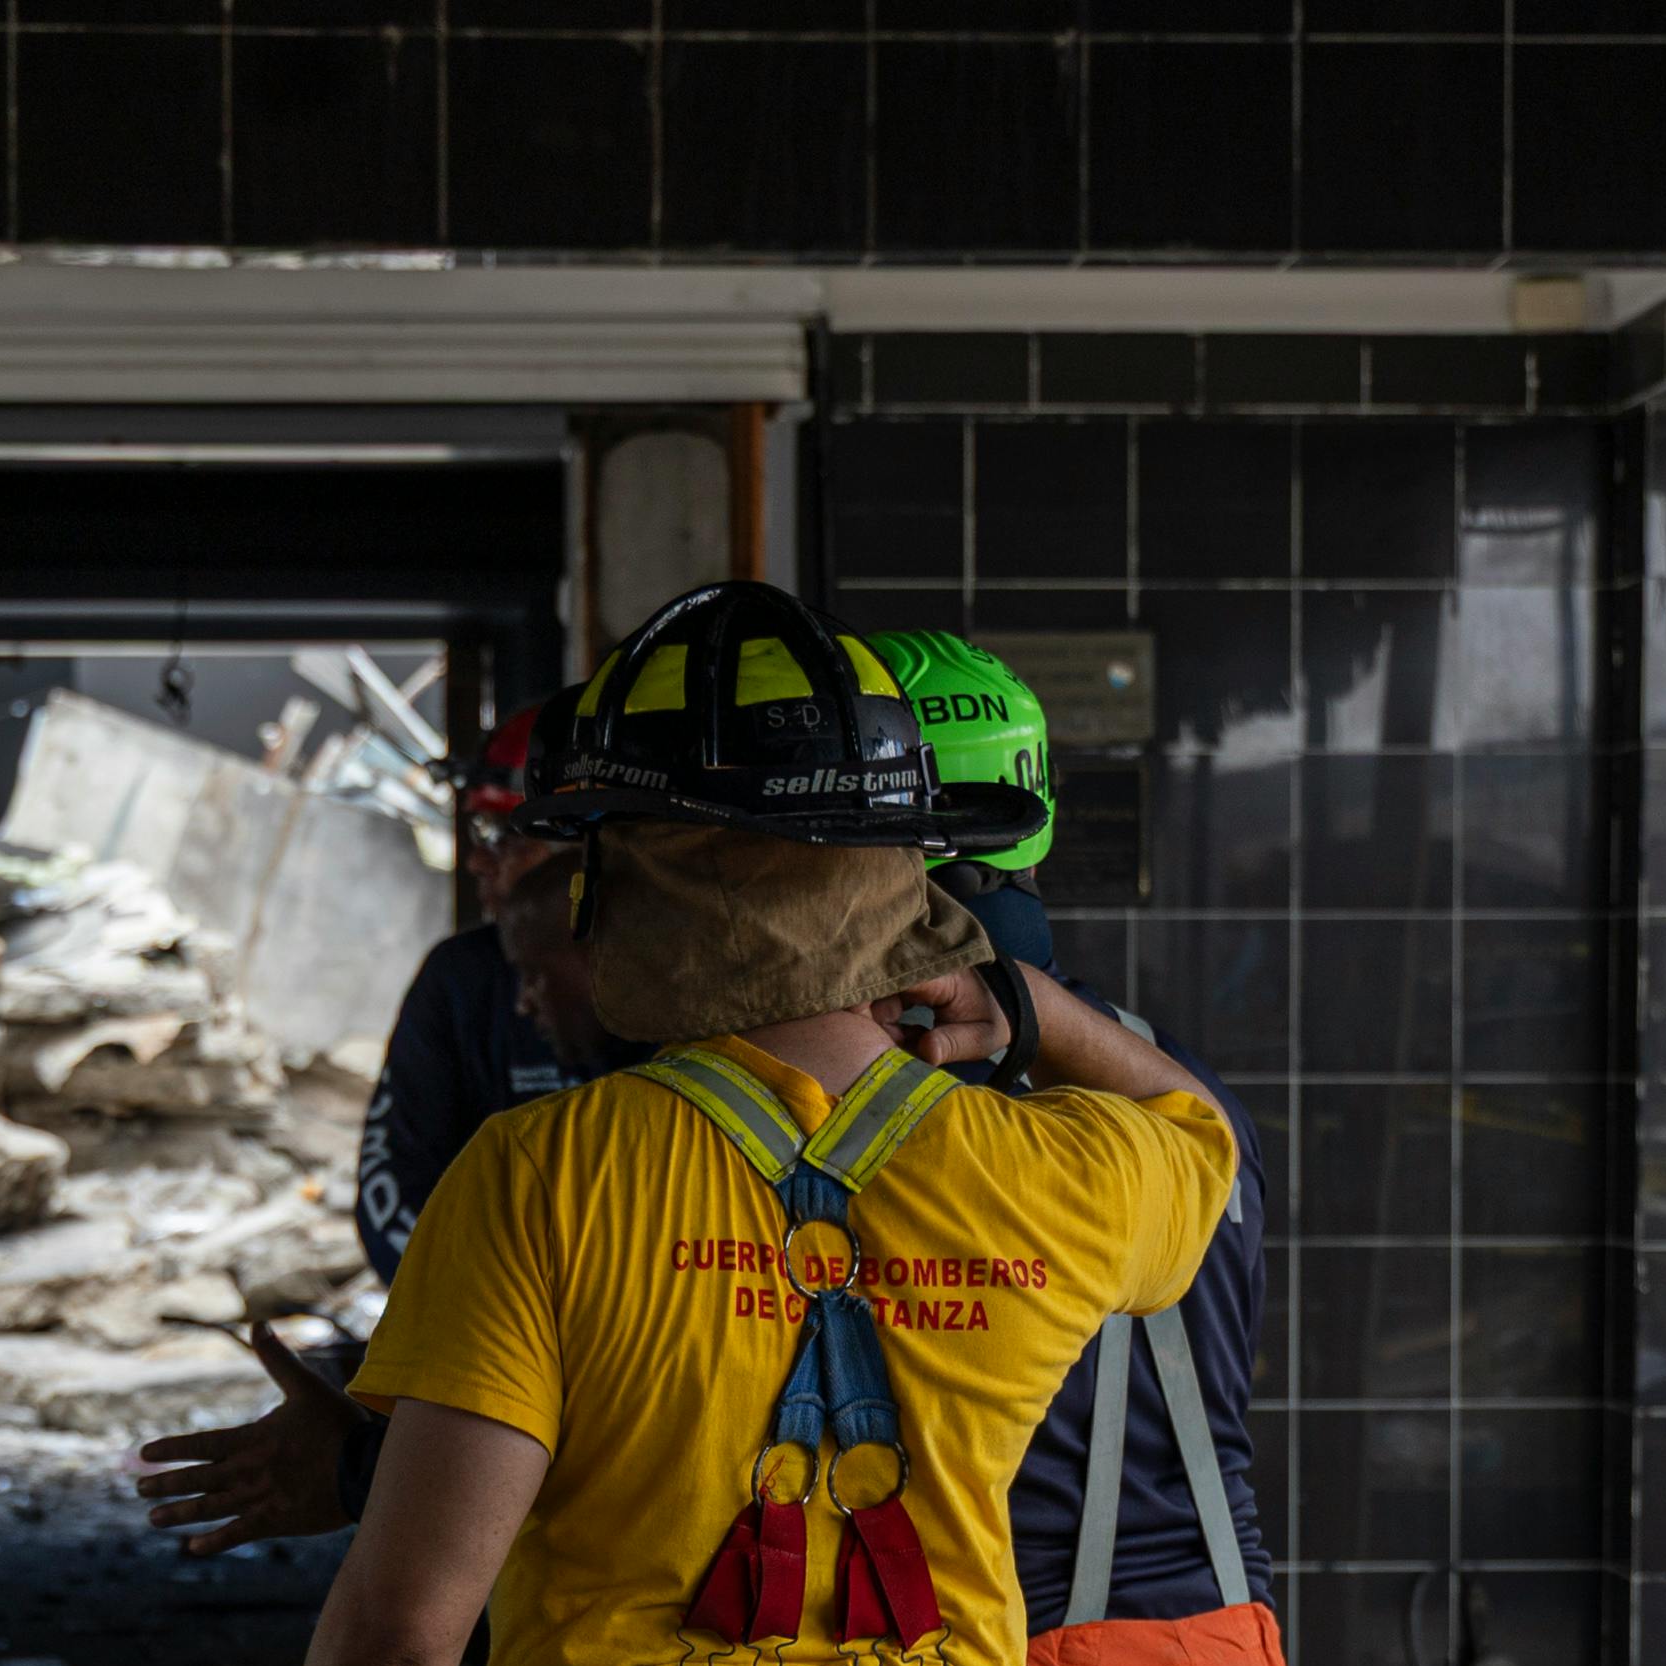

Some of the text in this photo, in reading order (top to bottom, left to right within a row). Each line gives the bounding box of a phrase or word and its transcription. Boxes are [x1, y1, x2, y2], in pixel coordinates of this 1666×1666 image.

[563, 752, 669, 791] sellstrom
[761, 768, 919, 797] sellstrom
[804, 1255, 846, 1285] DE
[859, 1256, 1048, 1290] BOMBEROS
[735, 1286, 990, 1332] DE CTANZA
